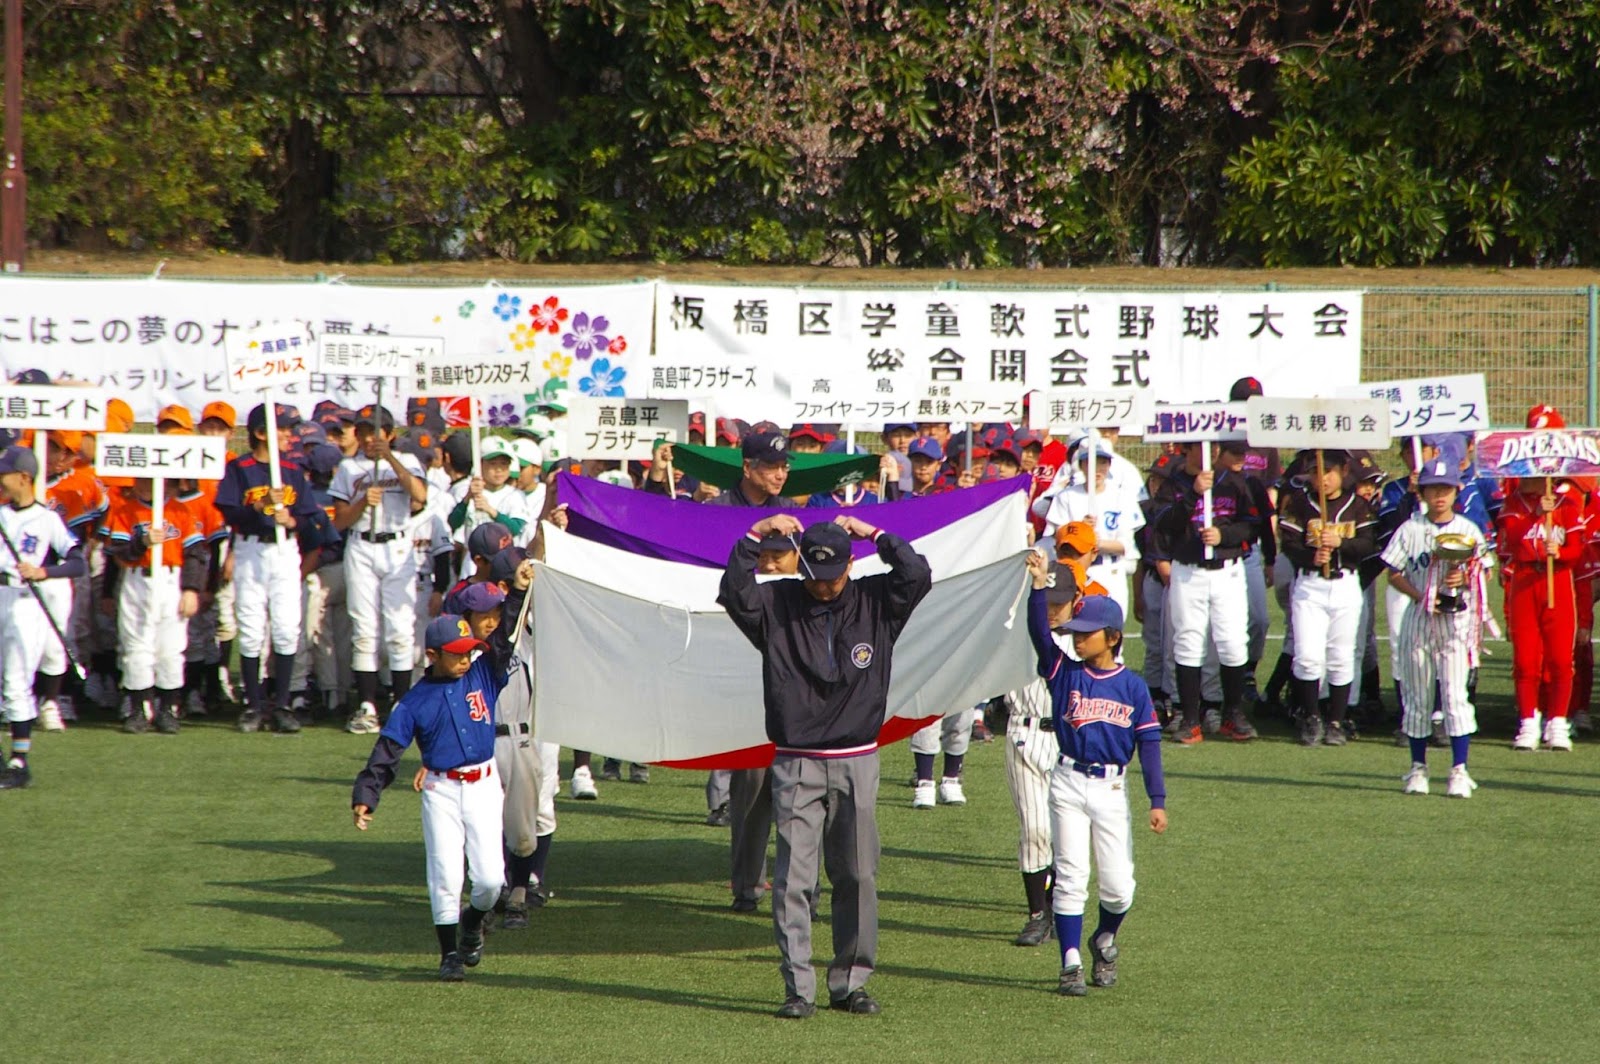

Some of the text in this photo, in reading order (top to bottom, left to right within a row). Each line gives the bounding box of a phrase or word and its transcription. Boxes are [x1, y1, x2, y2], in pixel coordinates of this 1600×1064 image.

[670, 295, 1349, 339] 板橋区学童軟式野球大会
[431, 361, 531, 386] 高島平セブンスターズ
[652, 366, 758, 389] 高島平ブラザーズ
[867, 347, 1151, 387] 総合開会式
[1418, 383, 1451, 401] 徳丸
[0, 396, 99, 419] 島エイト
[598, 406, 660, 427] 高島平
[795, 399, 911, 418] ファイヤーフライ
[1050, 396, 1134, 423] 東新クラブ
[1260, 413, 1377, 433] 徳丸親和会
[104, 444, 216, 469] 高島エイト
[1496, 432, 1600, 468] DREAMS
[1063, 690, 1134, 726] FIREFLY
